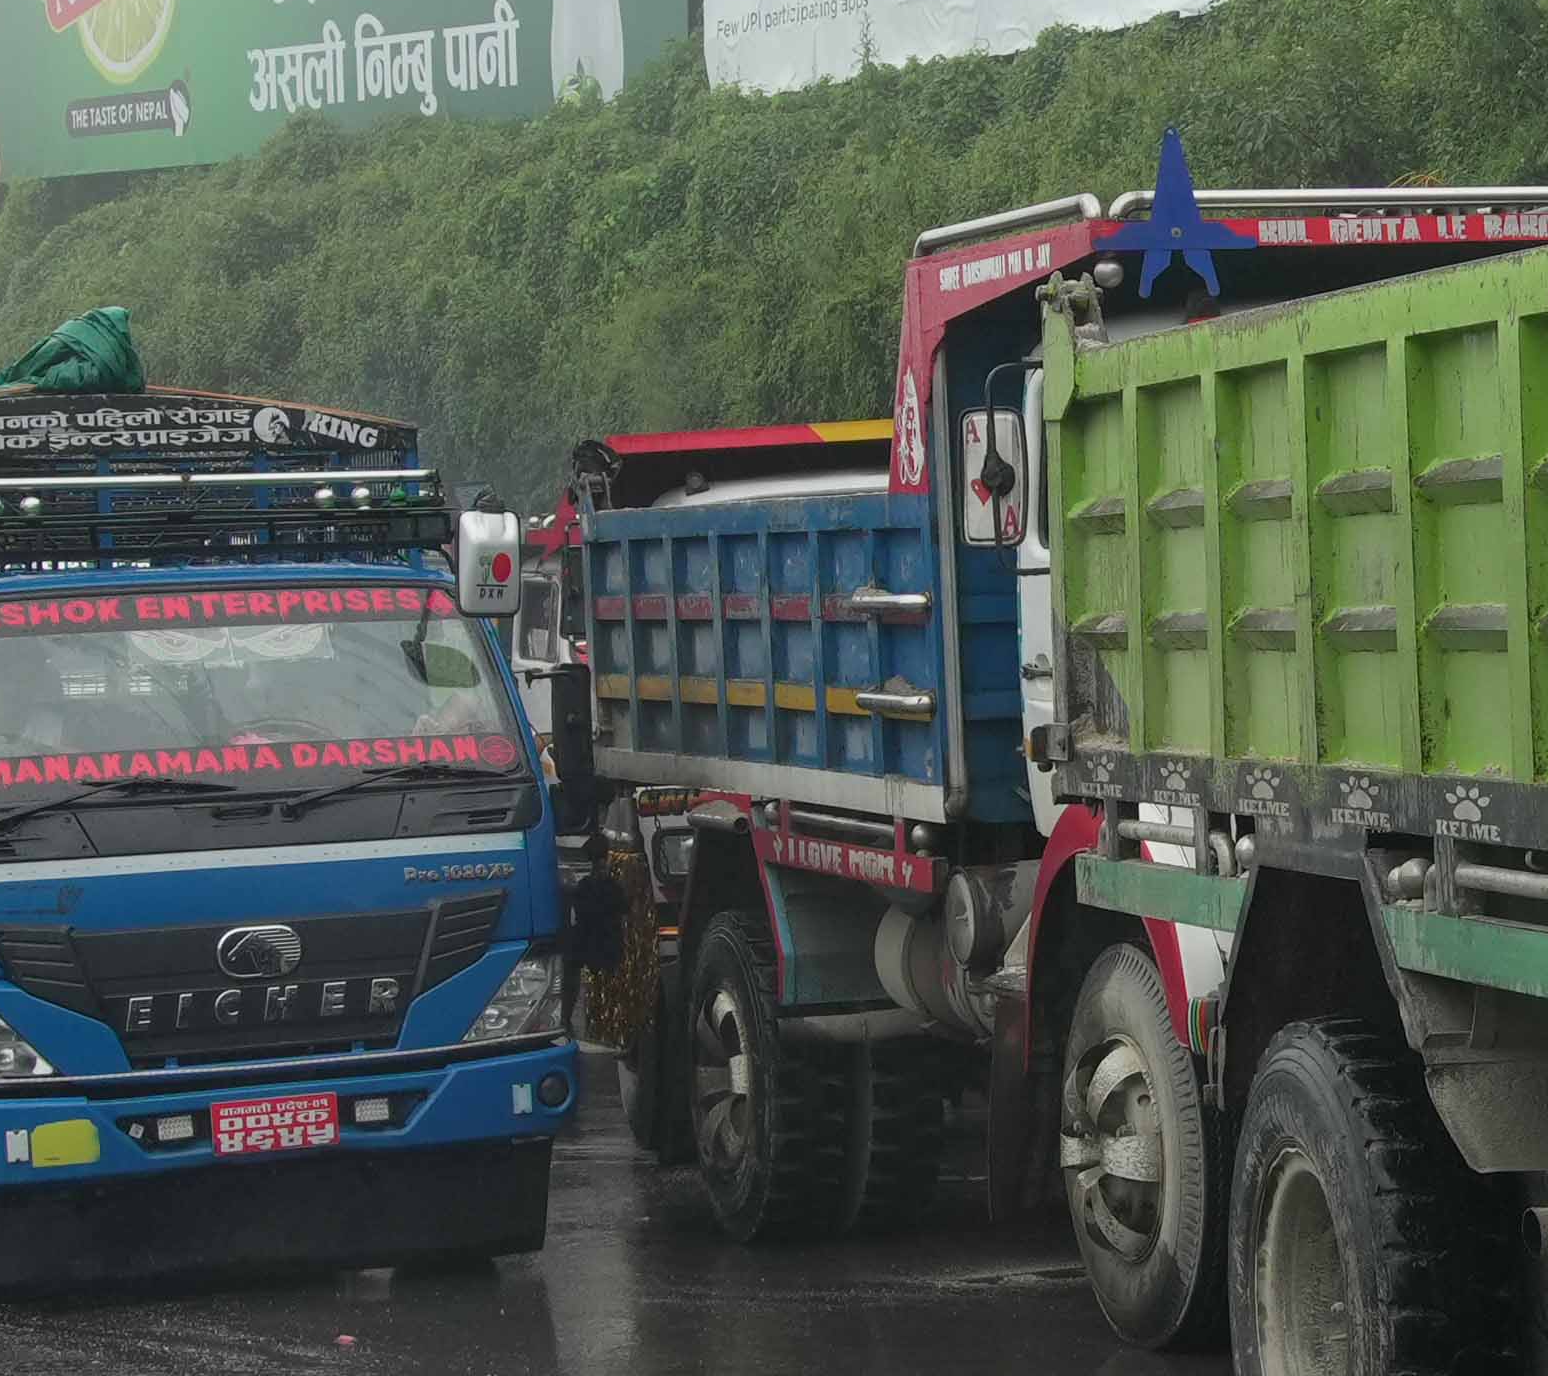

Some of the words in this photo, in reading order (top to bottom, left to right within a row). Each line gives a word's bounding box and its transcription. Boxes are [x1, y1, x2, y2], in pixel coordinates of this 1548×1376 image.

[716, 17, 740, 40] Few
[741, 10, 762, 33] UPI
[247, 20, 346, 113] असली
[354, 13, 439, 116] निम्बु
[71, 110, 89, 129] THE
[89, 105, 118, 126] TASTE
[119, 103, 133, 123] OF
[135, 99, 168, 122] NEPAL
[1437, 216, 1468, 239] LE
[309, 413, 379, 448] KING
[138, 589, 420, 623] ENTERPRISES
[292, 733, 480, 769] DARSHAN
[1154, 790, 1200, 807] KELME
[1239, 799, 1291, 818] KELME
[788, 837, 795, 863] I
[799, 840, 842, 873] LOVE
[849, 849, 895, 884] MOM
[126, 977, 399, 1032] EICHER
